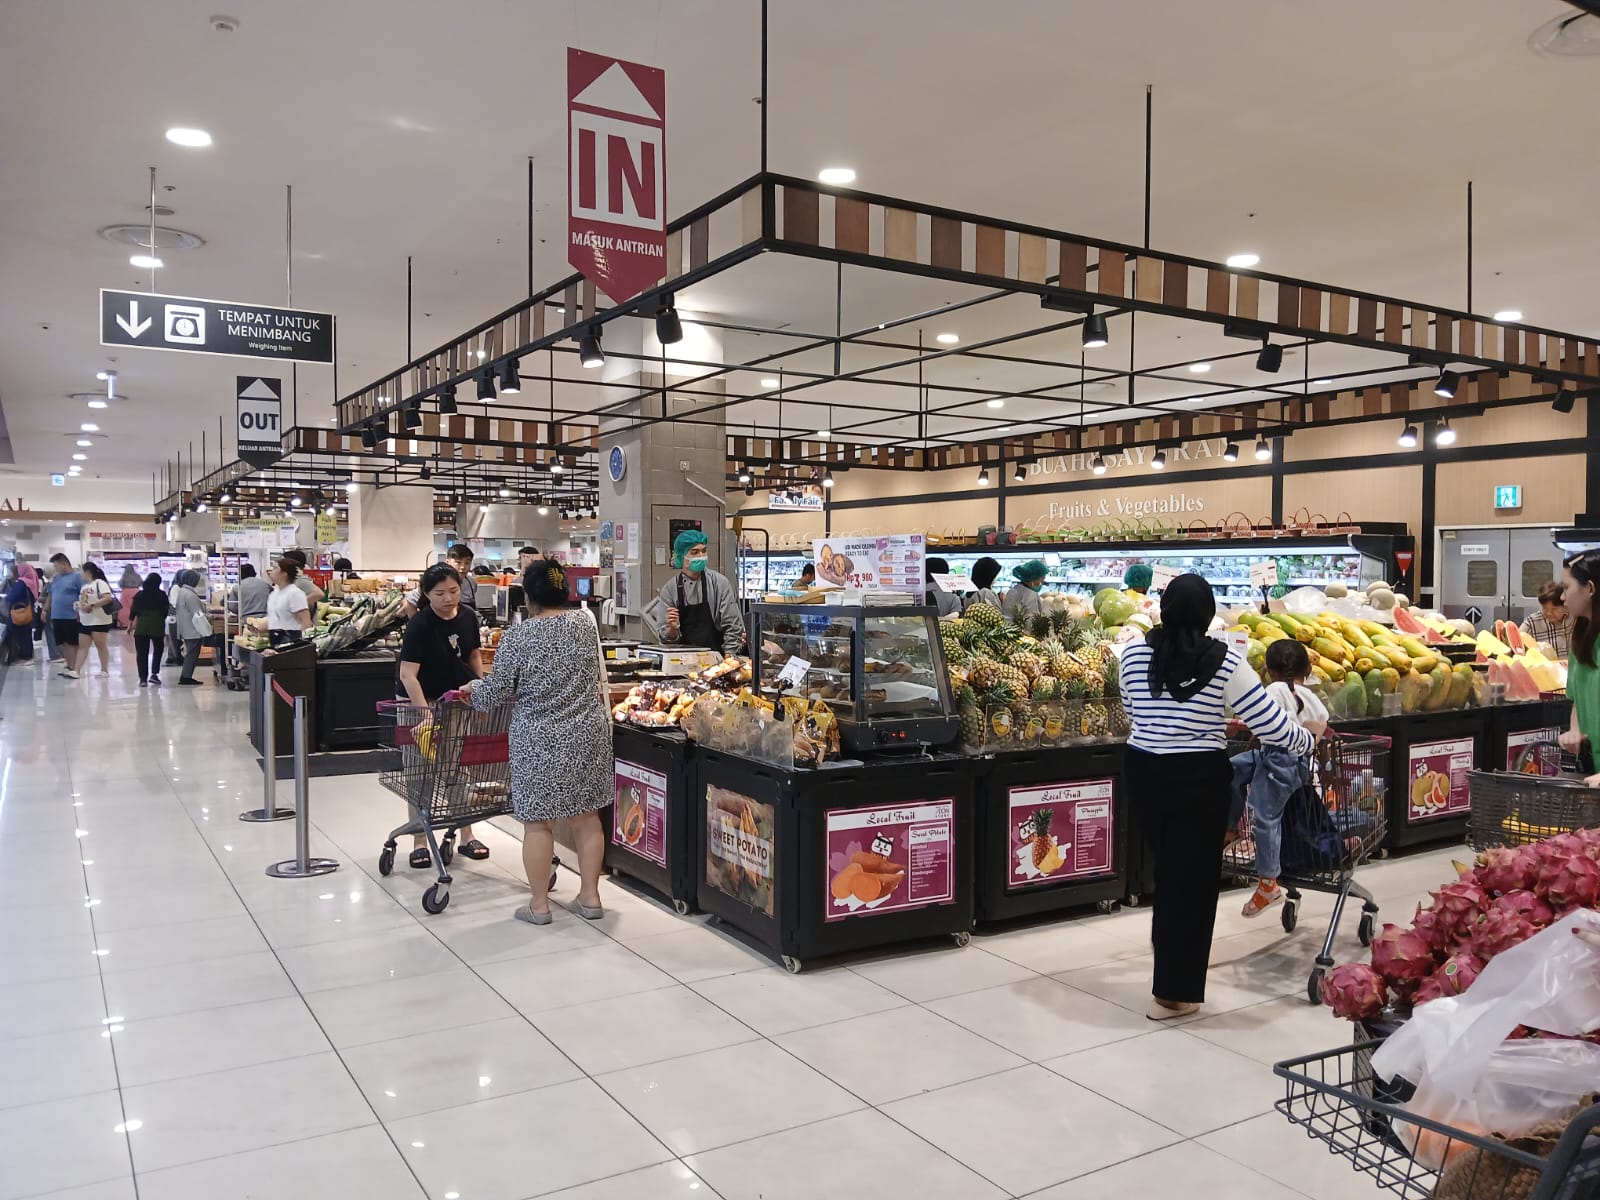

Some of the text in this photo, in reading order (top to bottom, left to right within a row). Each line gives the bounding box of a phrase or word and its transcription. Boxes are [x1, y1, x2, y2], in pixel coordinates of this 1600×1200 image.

[578, 127, 657, 221] IN
[571, 231, 664, 258] MASUK ANTRIAN
[217, 309, 320, 330] TEMPAT UNTUK
[228, 324, 312, 343] MENIMBANG
[248, 342, 293, 352] Weighing Item
[240, 411, 279, 431] OUT
[1049, 493, 1205, 519] Fruits & Vegetables
[1040, 789, 1081, 802] Local Fruit
[866, 810, 916, 825] Local Fruit
[712, 827, 735, 846] SWEET
[736, 837, 768, 860] POTATO
